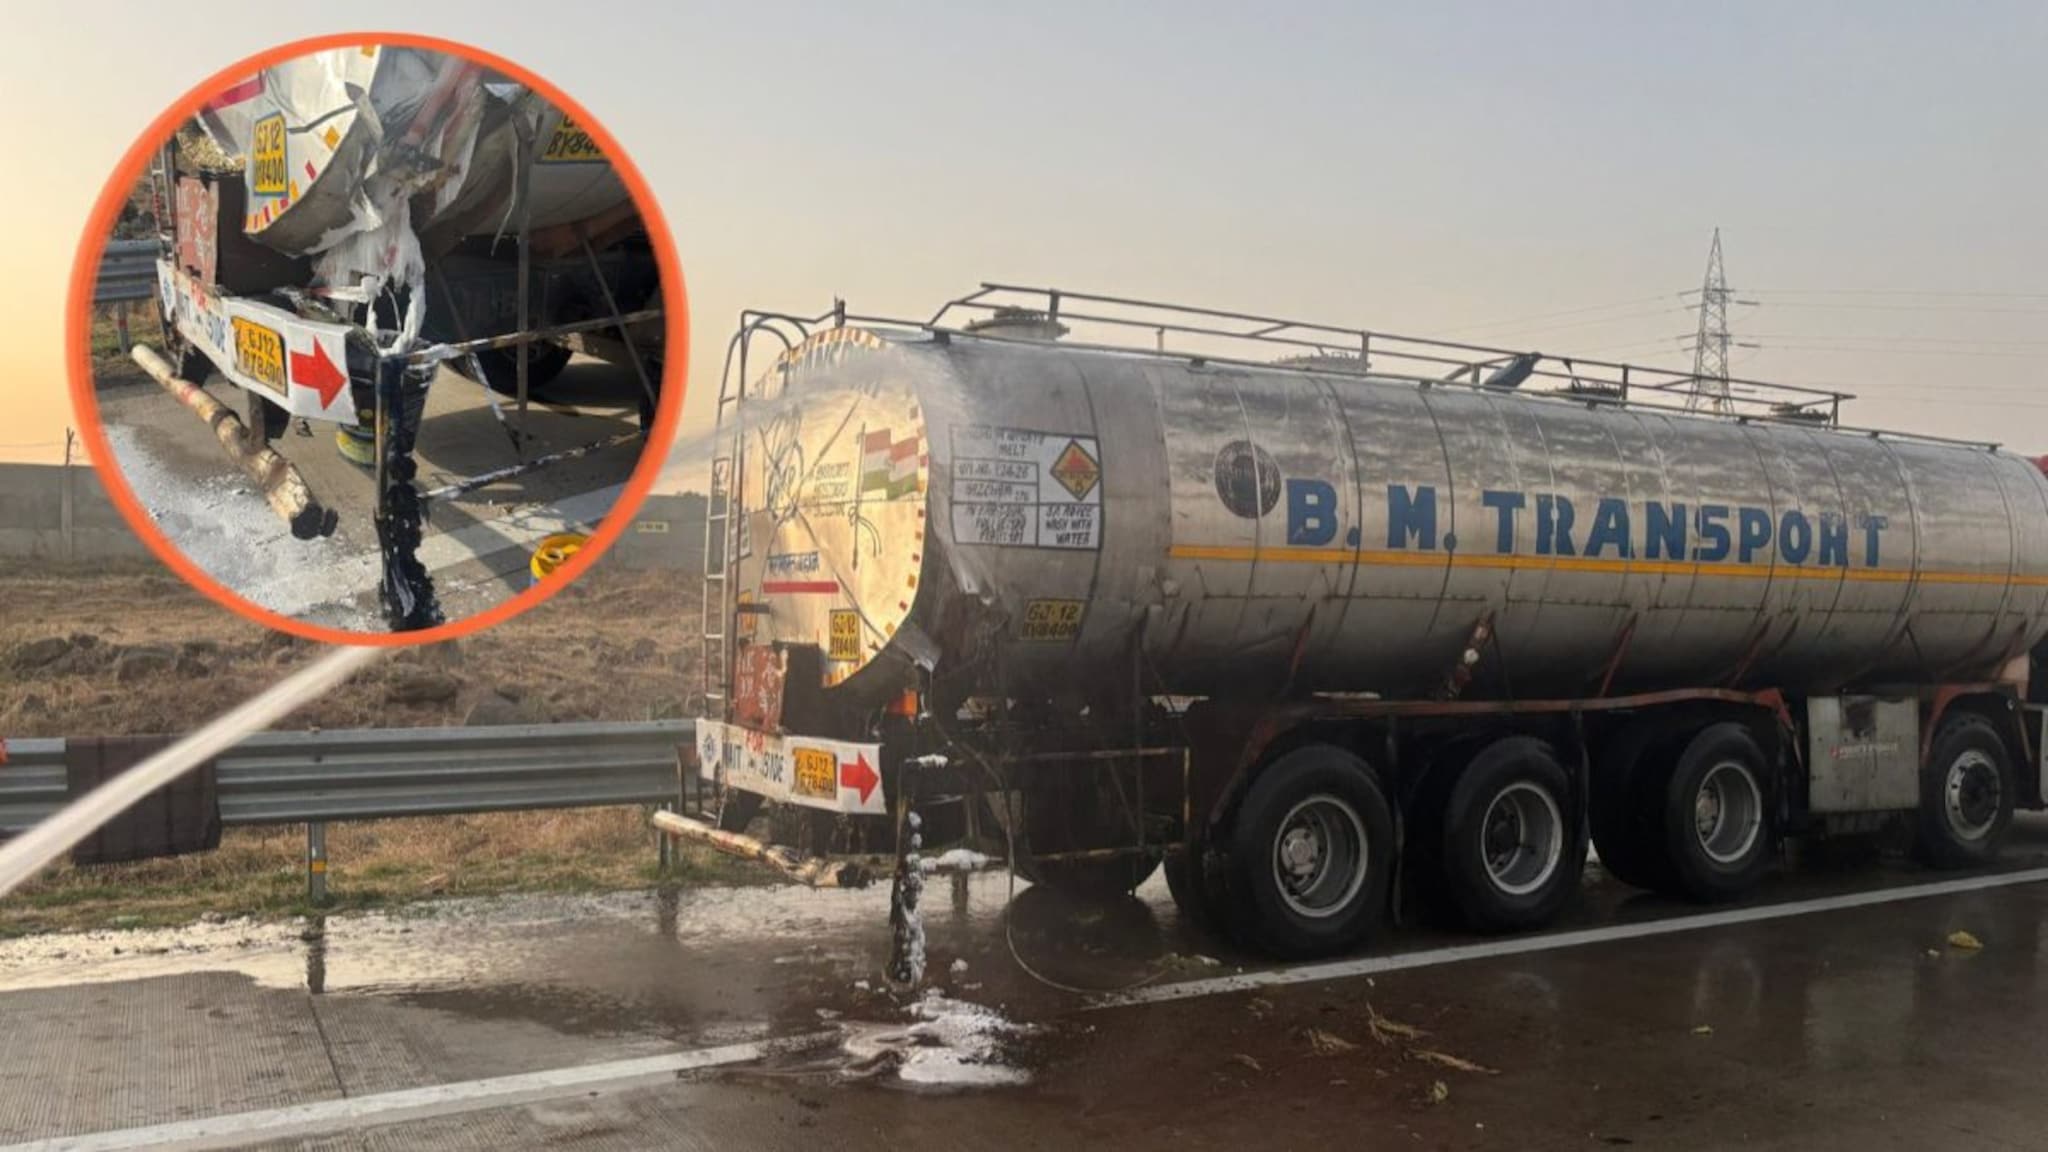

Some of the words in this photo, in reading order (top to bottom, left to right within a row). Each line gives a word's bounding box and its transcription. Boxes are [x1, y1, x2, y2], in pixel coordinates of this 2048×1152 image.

[1287, 479, 1360, 546] B.
[1387, 484, 1457, 552] M.
[1483, 490, 1889, 567] TRANSPORT
